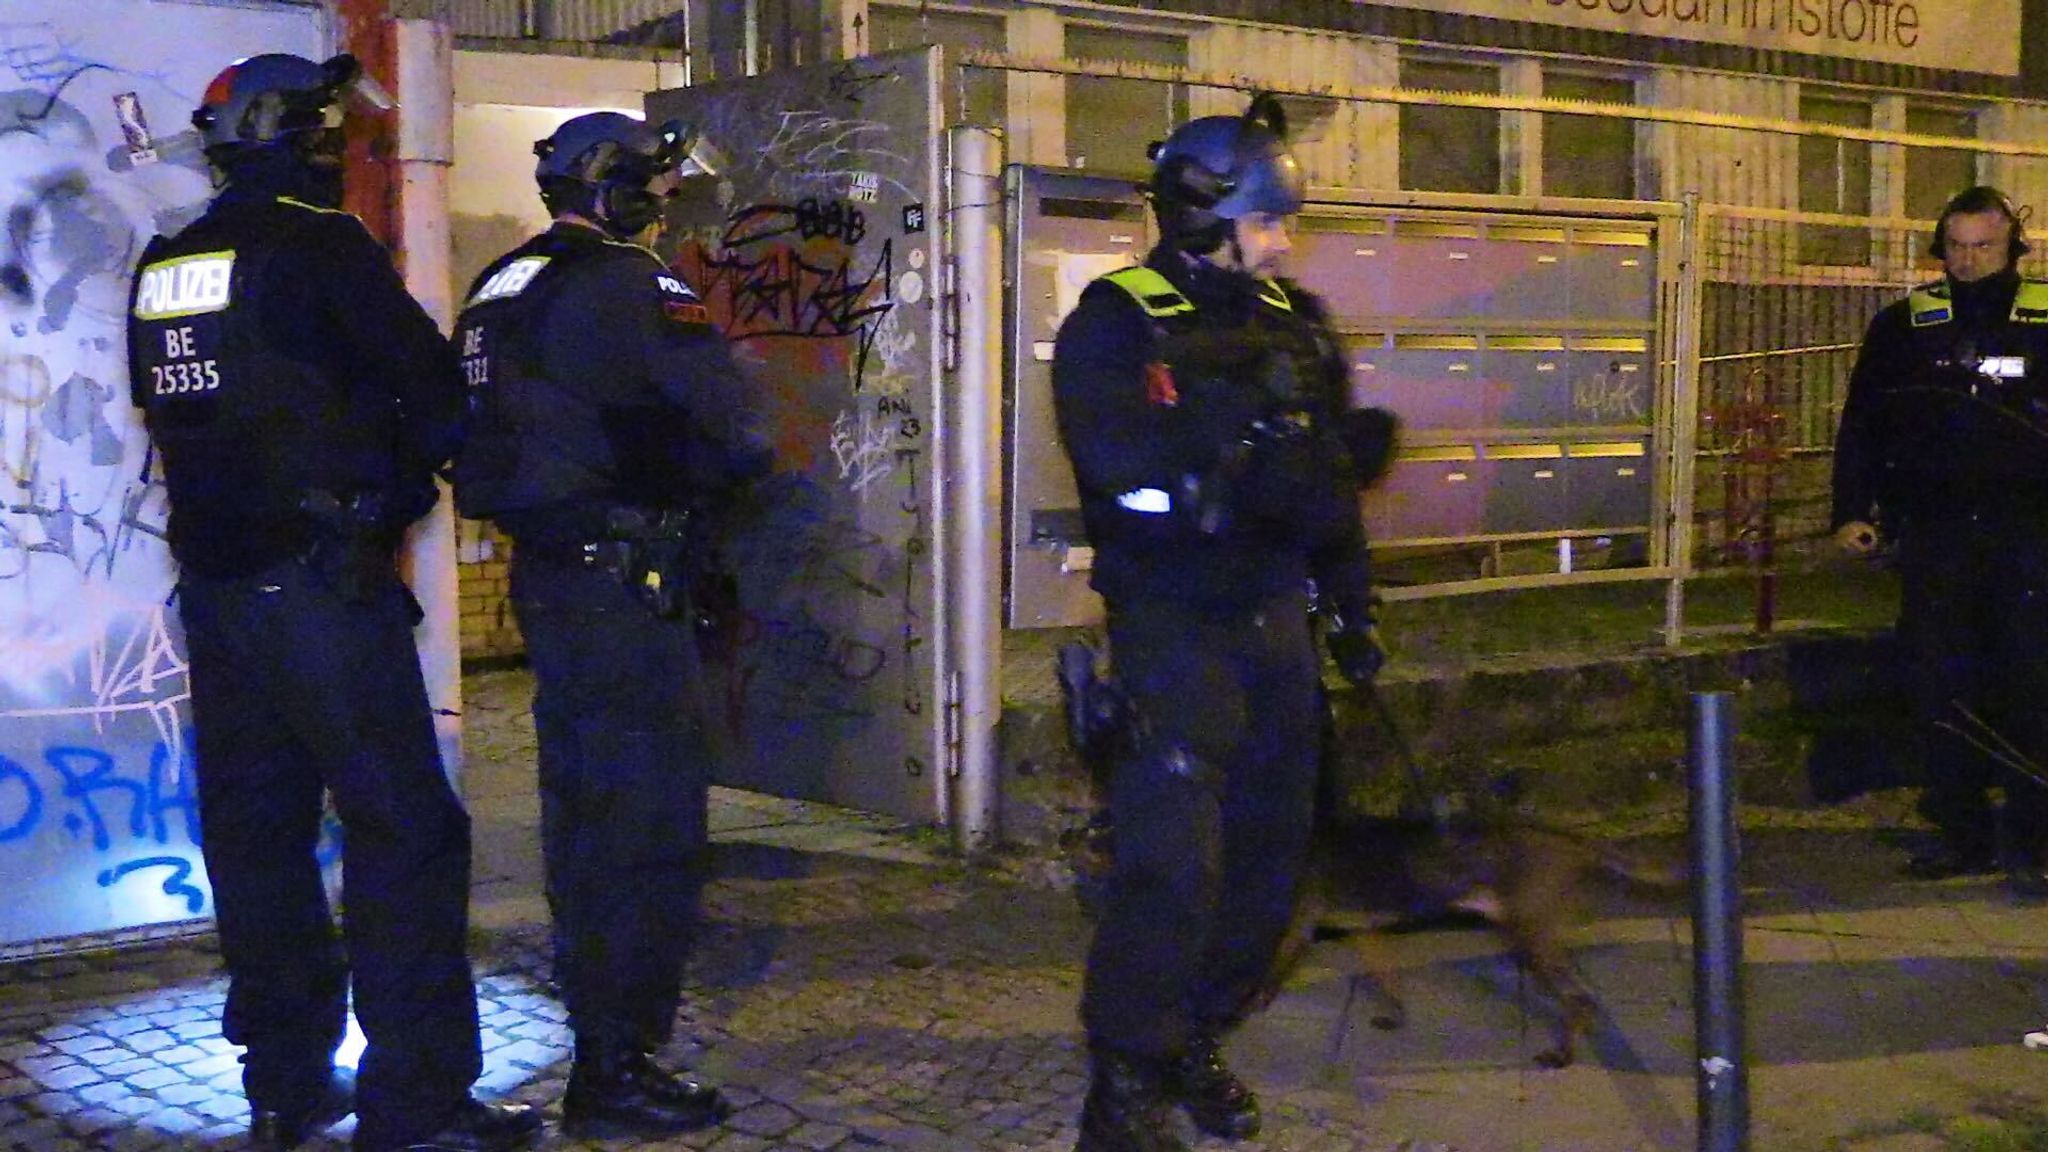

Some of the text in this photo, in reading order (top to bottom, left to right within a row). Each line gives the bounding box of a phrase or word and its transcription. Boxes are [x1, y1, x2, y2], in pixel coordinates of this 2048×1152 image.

[139, 258, 232, 315] POLIZEI
[165, 326, 196, 358] BE
[151, 360, 220, 395] 25335
